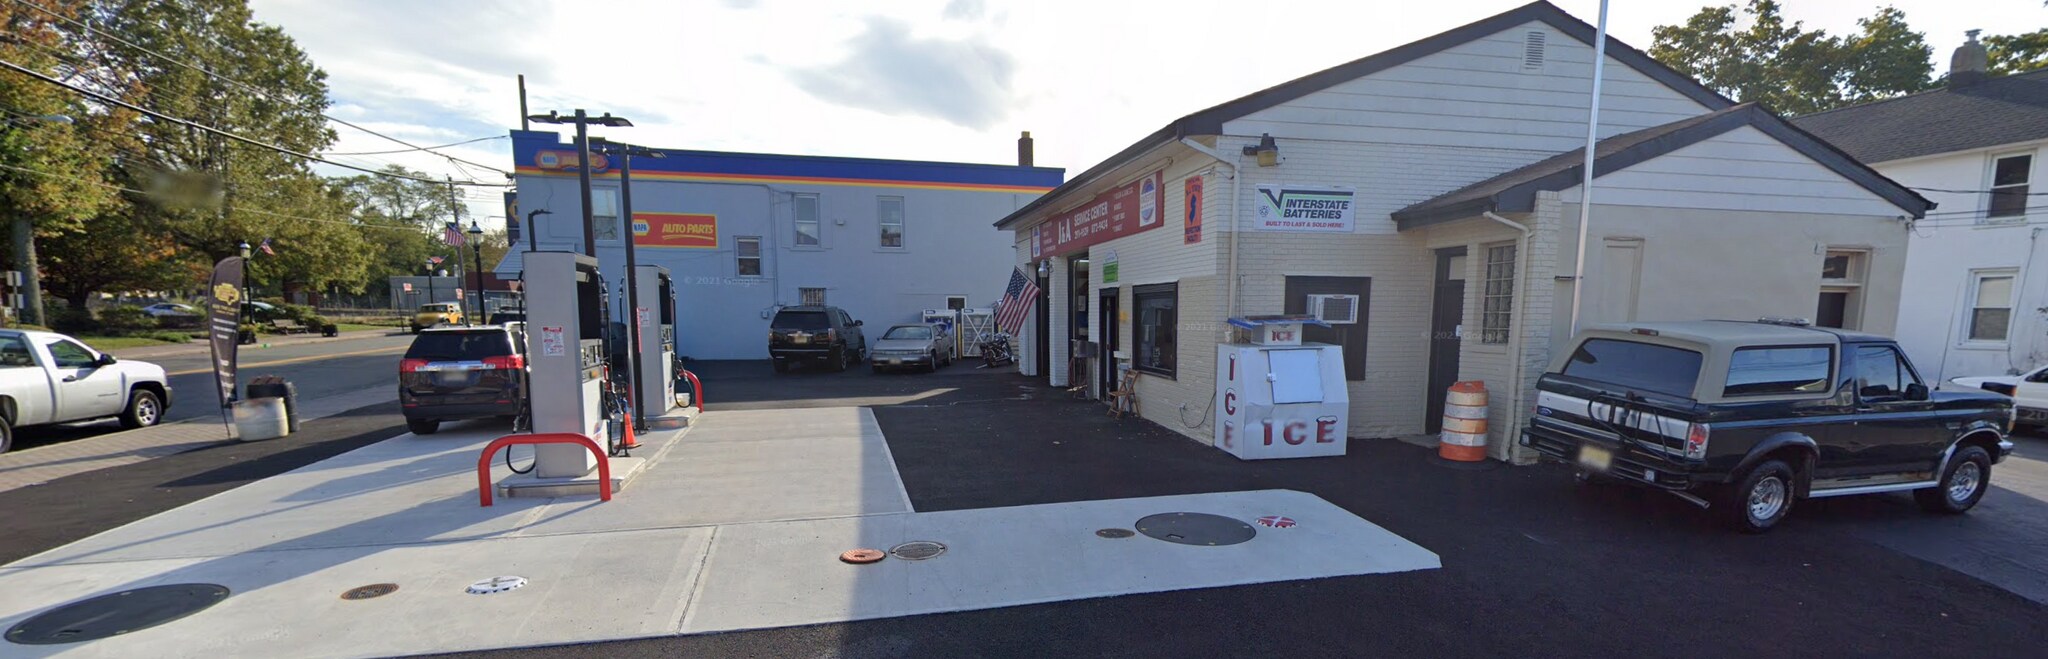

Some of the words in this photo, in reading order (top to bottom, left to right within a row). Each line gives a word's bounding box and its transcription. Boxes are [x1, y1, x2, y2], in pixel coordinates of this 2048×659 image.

[1286, 199, 1349, 210] INTERSTATE
[1073, 207, 1091, 228] SERVICE
[1090, 201, 1109, 220] CENTER
[1283, 208, 1342, 220] BATTERIES
[633, 223, 647, 232] NAPA
[662, 223, 686, 234] AUTO
[687, 224, 714, 235] PARTS
[1271, 330, 1295, 341] ICE
[1223, 352, 1236, 449] ICE
[1261, 415, 1338, 446] ICE
